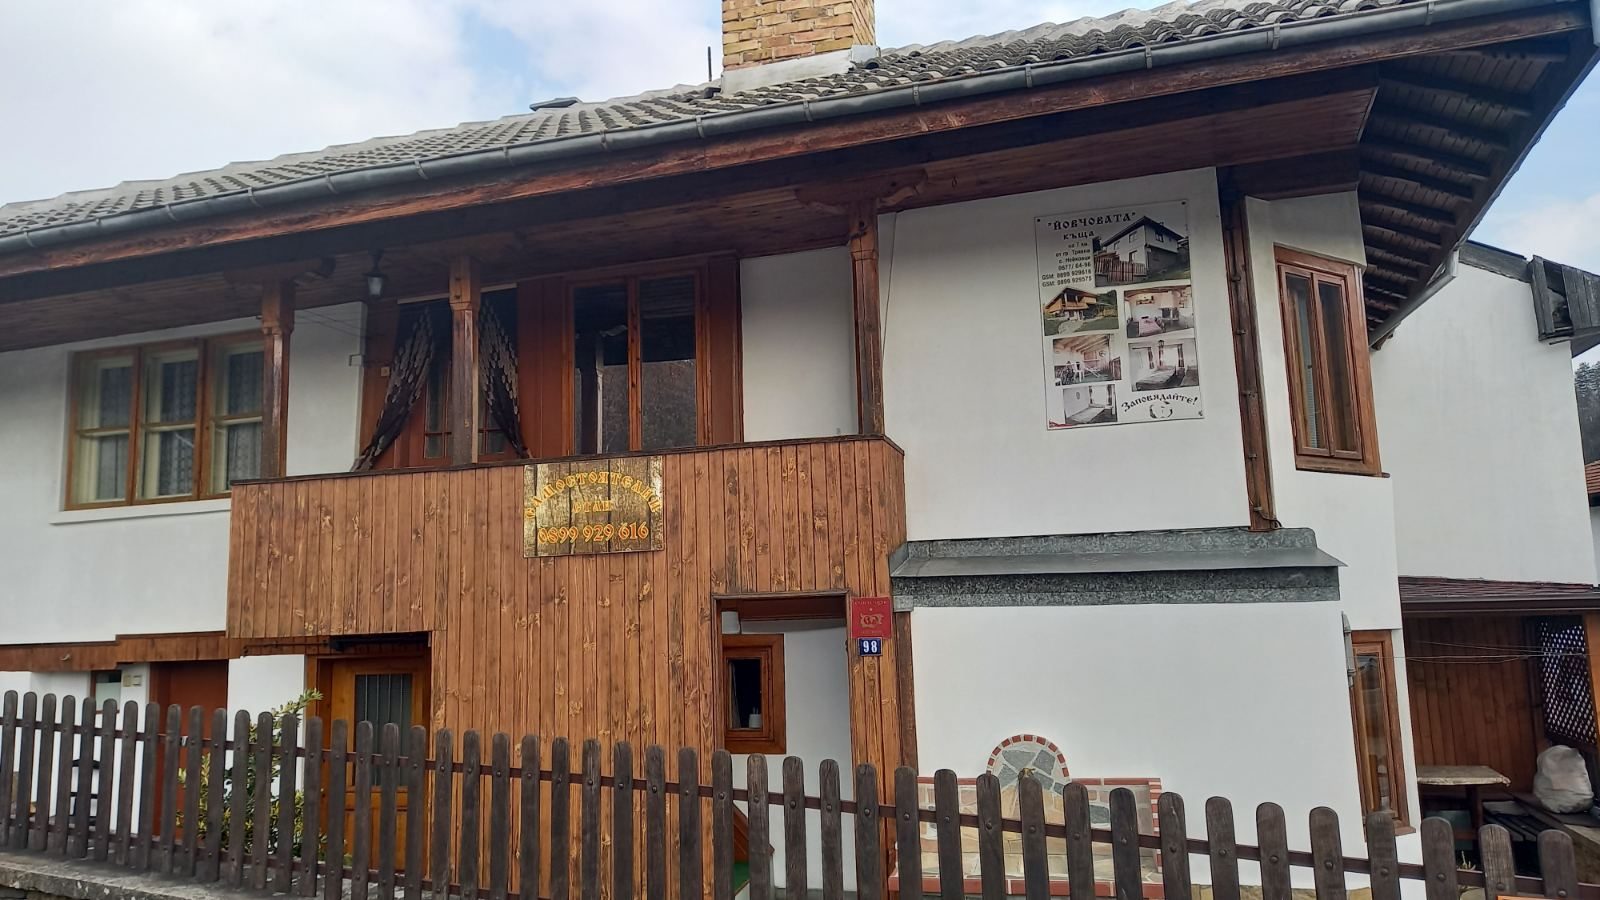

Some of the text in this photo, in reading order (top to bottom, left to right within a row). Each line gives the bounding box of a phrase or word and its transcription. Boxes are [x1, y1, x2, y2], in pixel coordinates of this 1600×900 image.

[538, 520, 649, 544] 0899 929 616
[862, 640, 878, 653] 98
